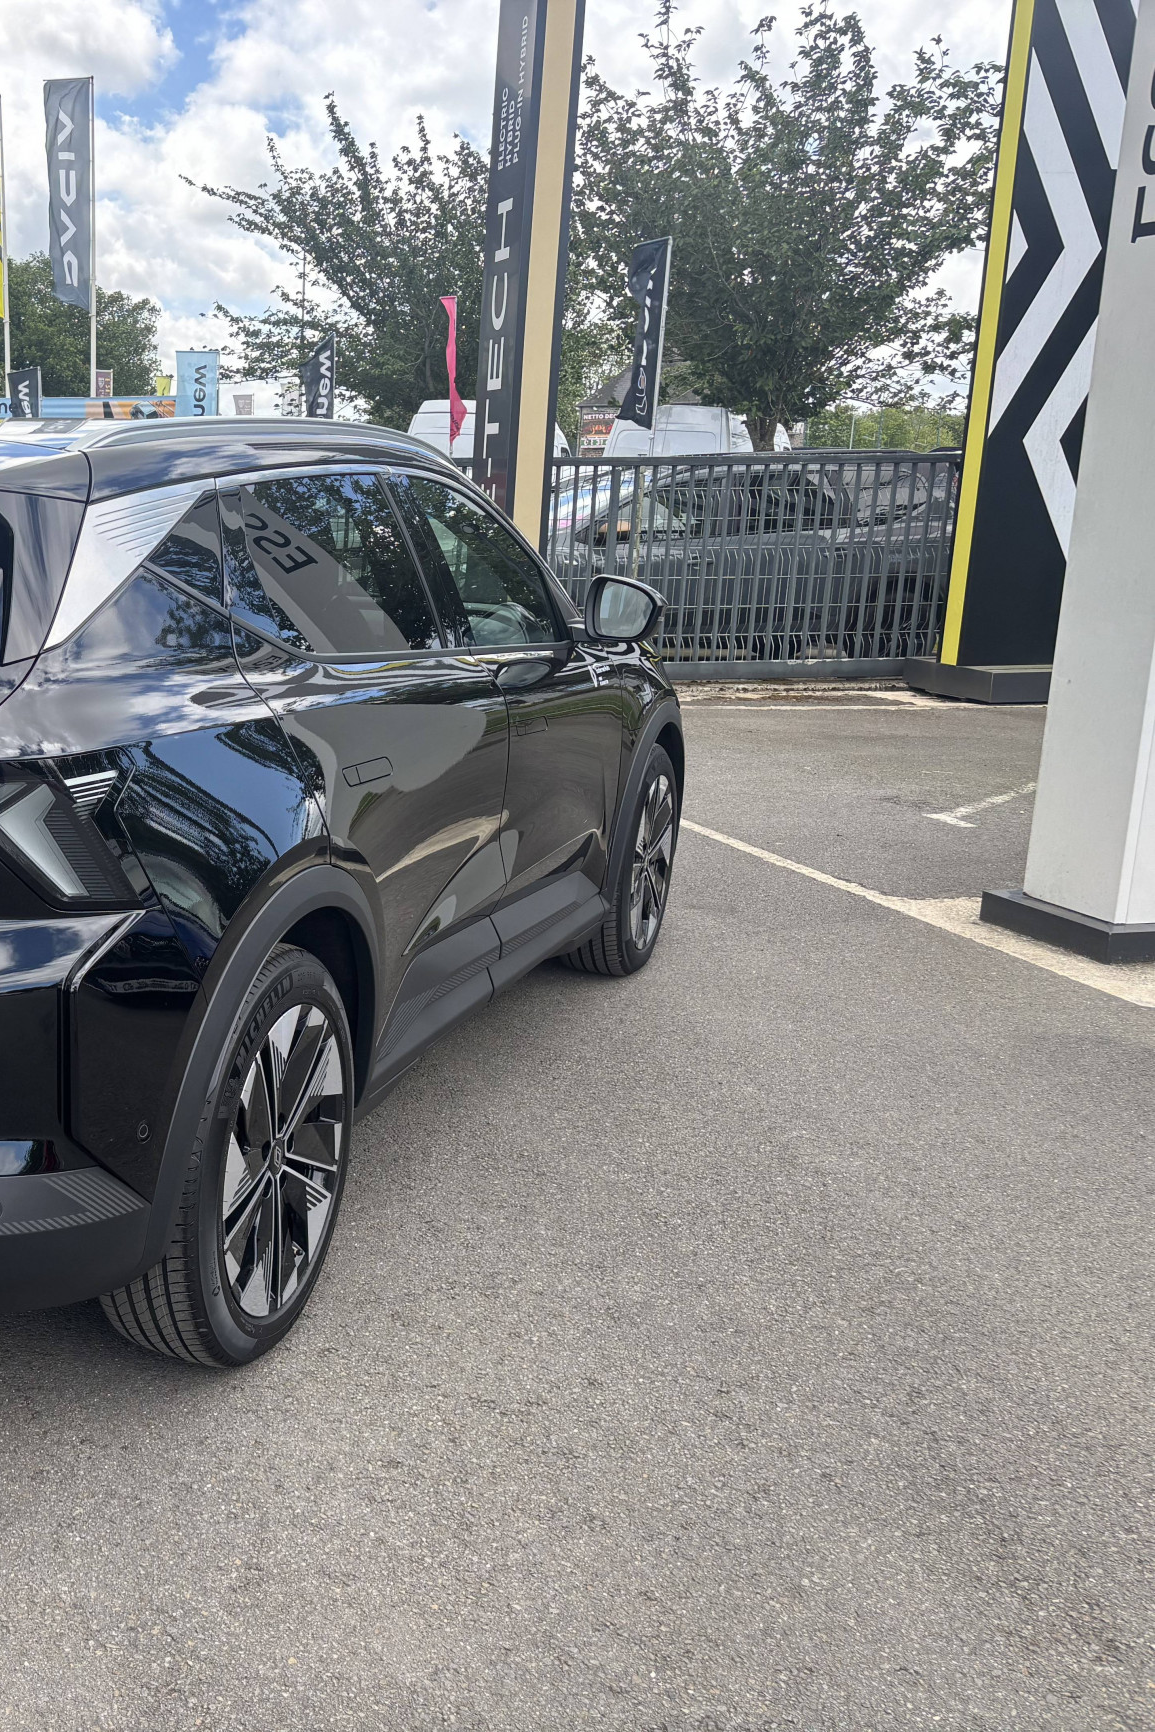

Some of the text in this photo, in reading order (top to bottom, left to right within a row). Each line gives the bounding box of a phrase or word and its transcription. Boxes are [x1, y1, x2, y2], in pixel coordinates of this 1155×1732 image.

[497, 87, 509, 171] ELECTRIC
[505, 100, 515, 167] HYBRID
[513, 15, 529, 164] PLUG-IN HYBRID
[237, 973, 293, 1076] MICHELIN
